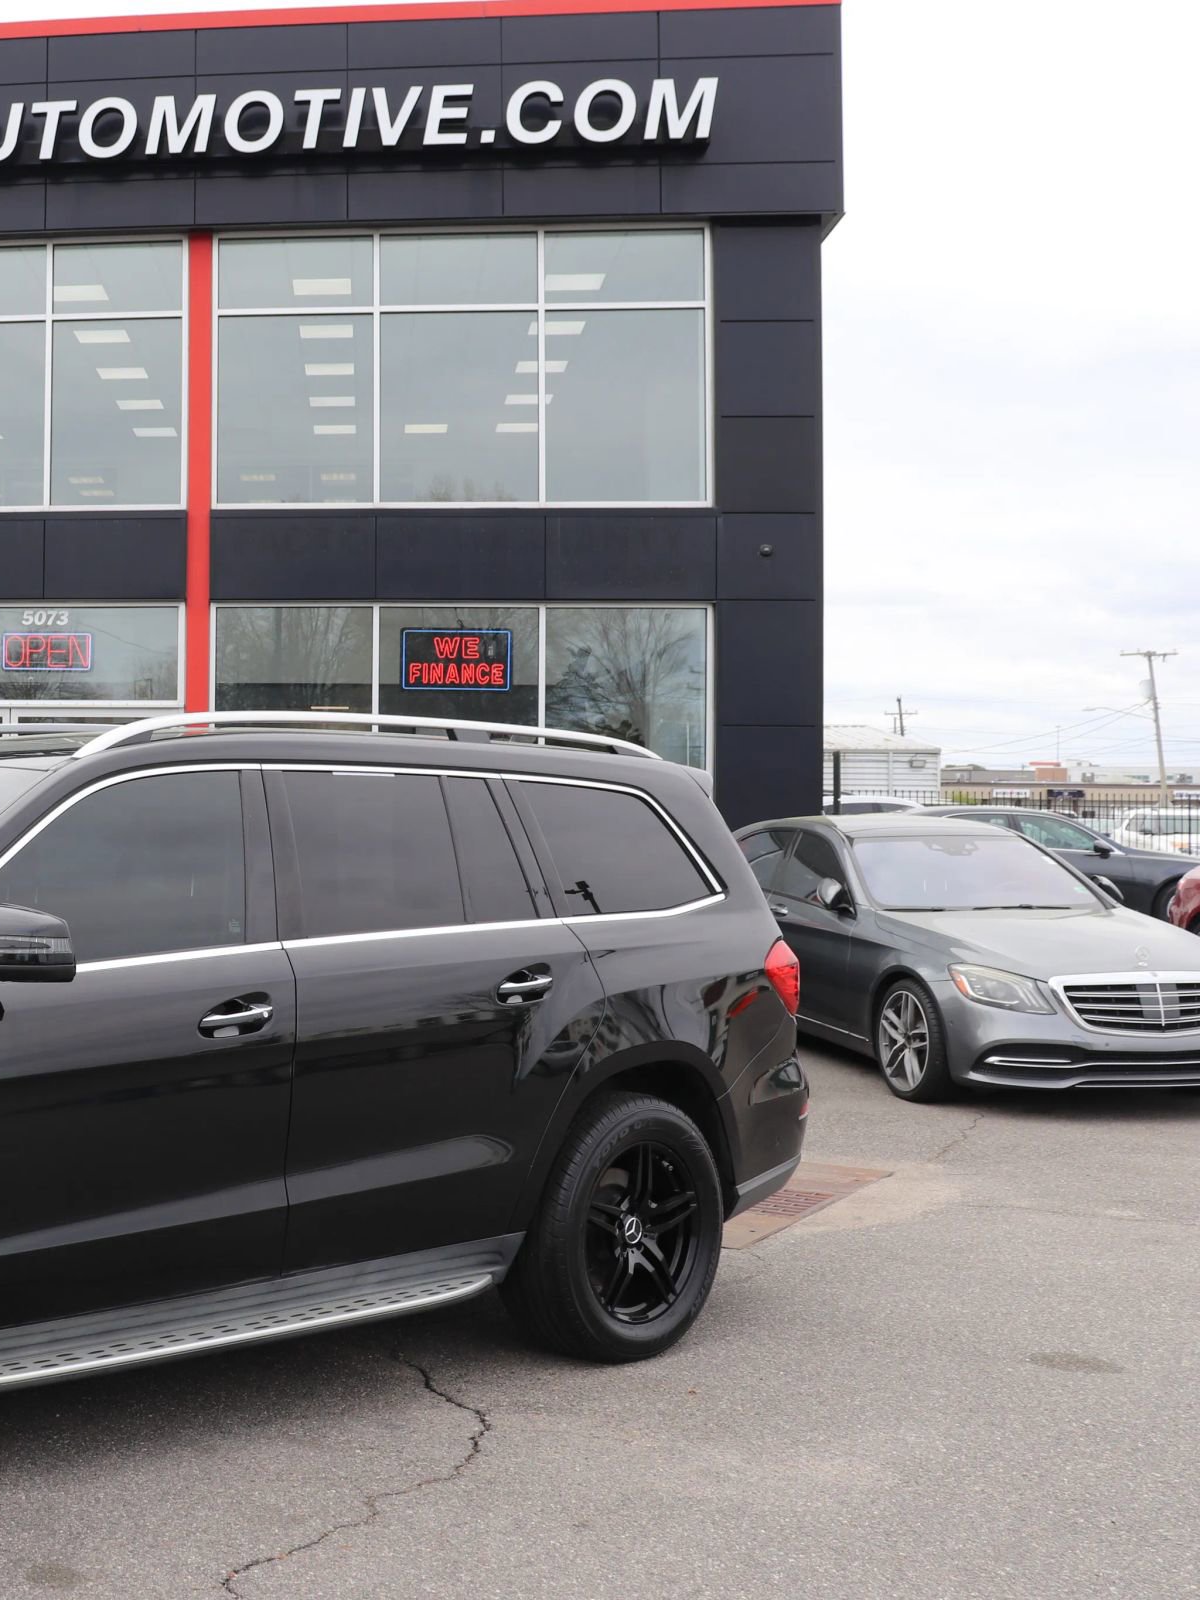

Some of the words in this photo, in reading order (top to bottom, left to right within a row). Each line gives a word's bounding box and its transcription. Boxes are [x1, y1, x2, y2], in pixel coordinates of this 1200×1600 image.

[21, 610, 69, 626] 5073
[5, 634, 89, 668] OPEN
[433, 636, 480, 659] WE
[408, 662, 504, 685] FINANCE
